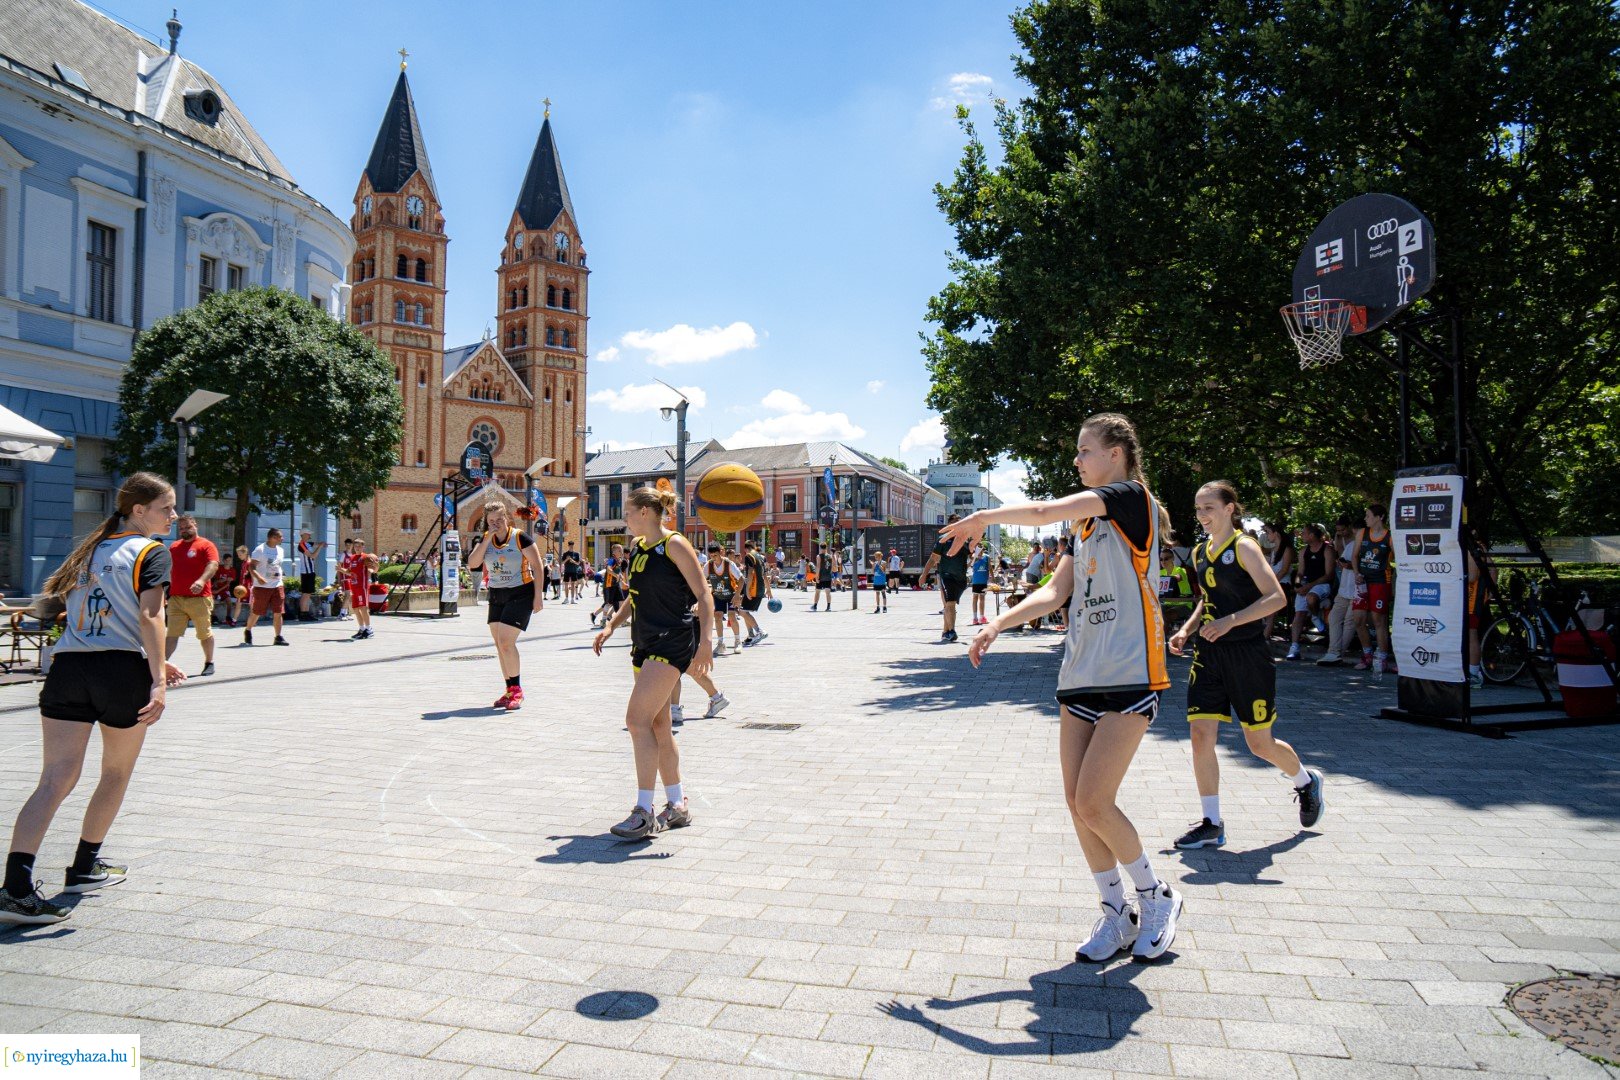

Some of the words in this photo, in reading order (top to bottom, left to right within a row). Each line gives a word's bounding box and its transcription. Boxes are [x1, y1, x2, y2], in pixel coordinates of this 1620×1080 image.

[1405, 229, 1416, 247] 2
[1369, 243, 1381, 252] Audi
[631, 553, 649, 572] 10
[1205, 566, 1217, 588] 6
[1412, 587, 1438, 595] molten
[1376, 599, 1383, 609] 8
[1403, 617, 1438, 627] POWER
[1416, 626, 1437, 634] ADE
[1417, 650, 1440, 663] TOTI
[1252, 699, 1267, 722] 6
